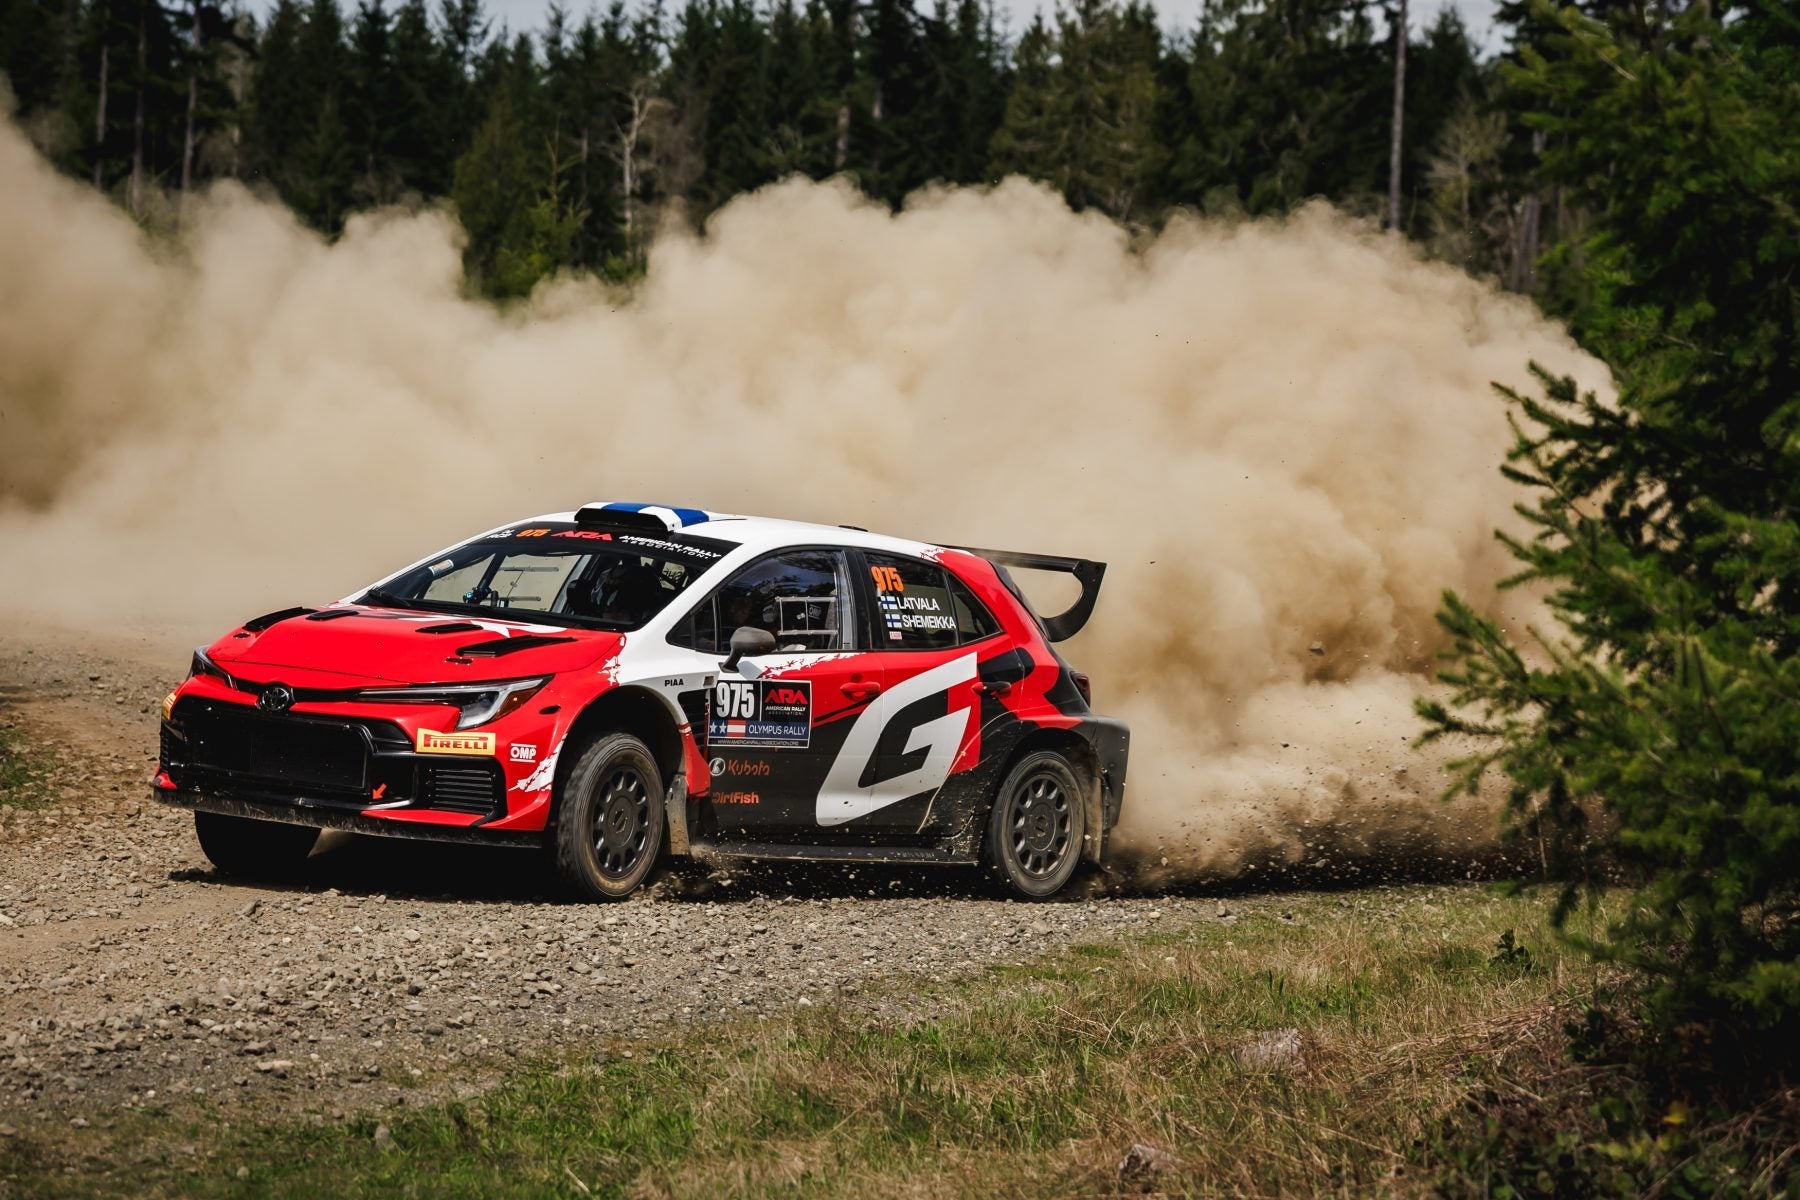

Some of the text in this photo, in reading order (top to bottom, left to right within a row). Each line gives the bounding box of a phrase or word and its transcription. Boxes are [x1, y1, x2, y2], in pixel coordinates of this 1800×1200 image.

[618, 535, 722, 558] AMERICAN RALLY
[870, 565, 905, 592] 975
[896, 597, 940, 611] LATVALA
[902, 614, 956, 629] SHEMEIKKA
[664, 678, 684, 687] PIAA
[716, 681, 755, 718] 975
[748, 724, 806, 736] OLYMPUS RALLY
[424, 733, 488, 750] PIRELLI
[510, 747, 537, 760] OMP
[728, 759, 770, 776] Kubota
